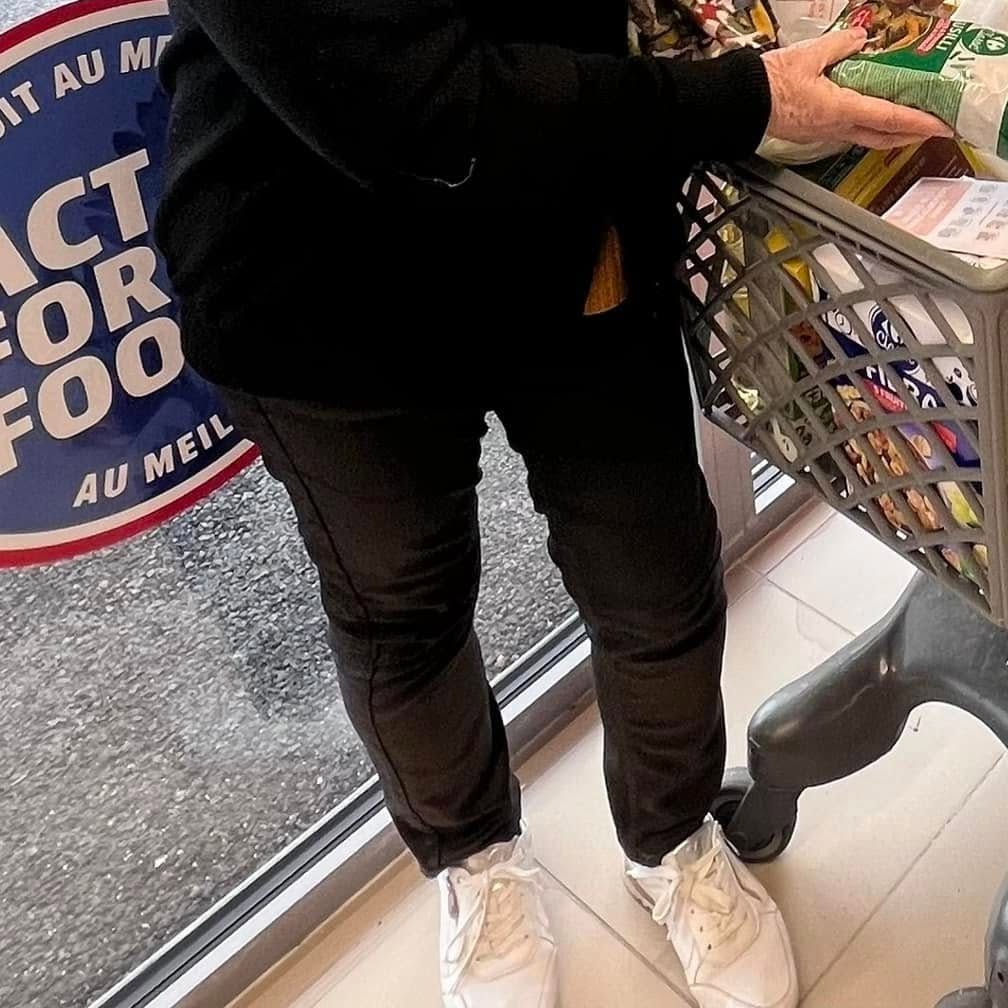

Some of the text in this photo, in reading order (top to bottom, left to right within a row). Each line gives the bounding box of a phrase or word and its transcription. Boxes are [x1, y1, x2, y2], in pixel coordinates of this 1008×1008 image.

[53, 48, 105, 99] AU
[0, 246, 172, 367] OR
[72, 413, 235, 508] AU MEIL
